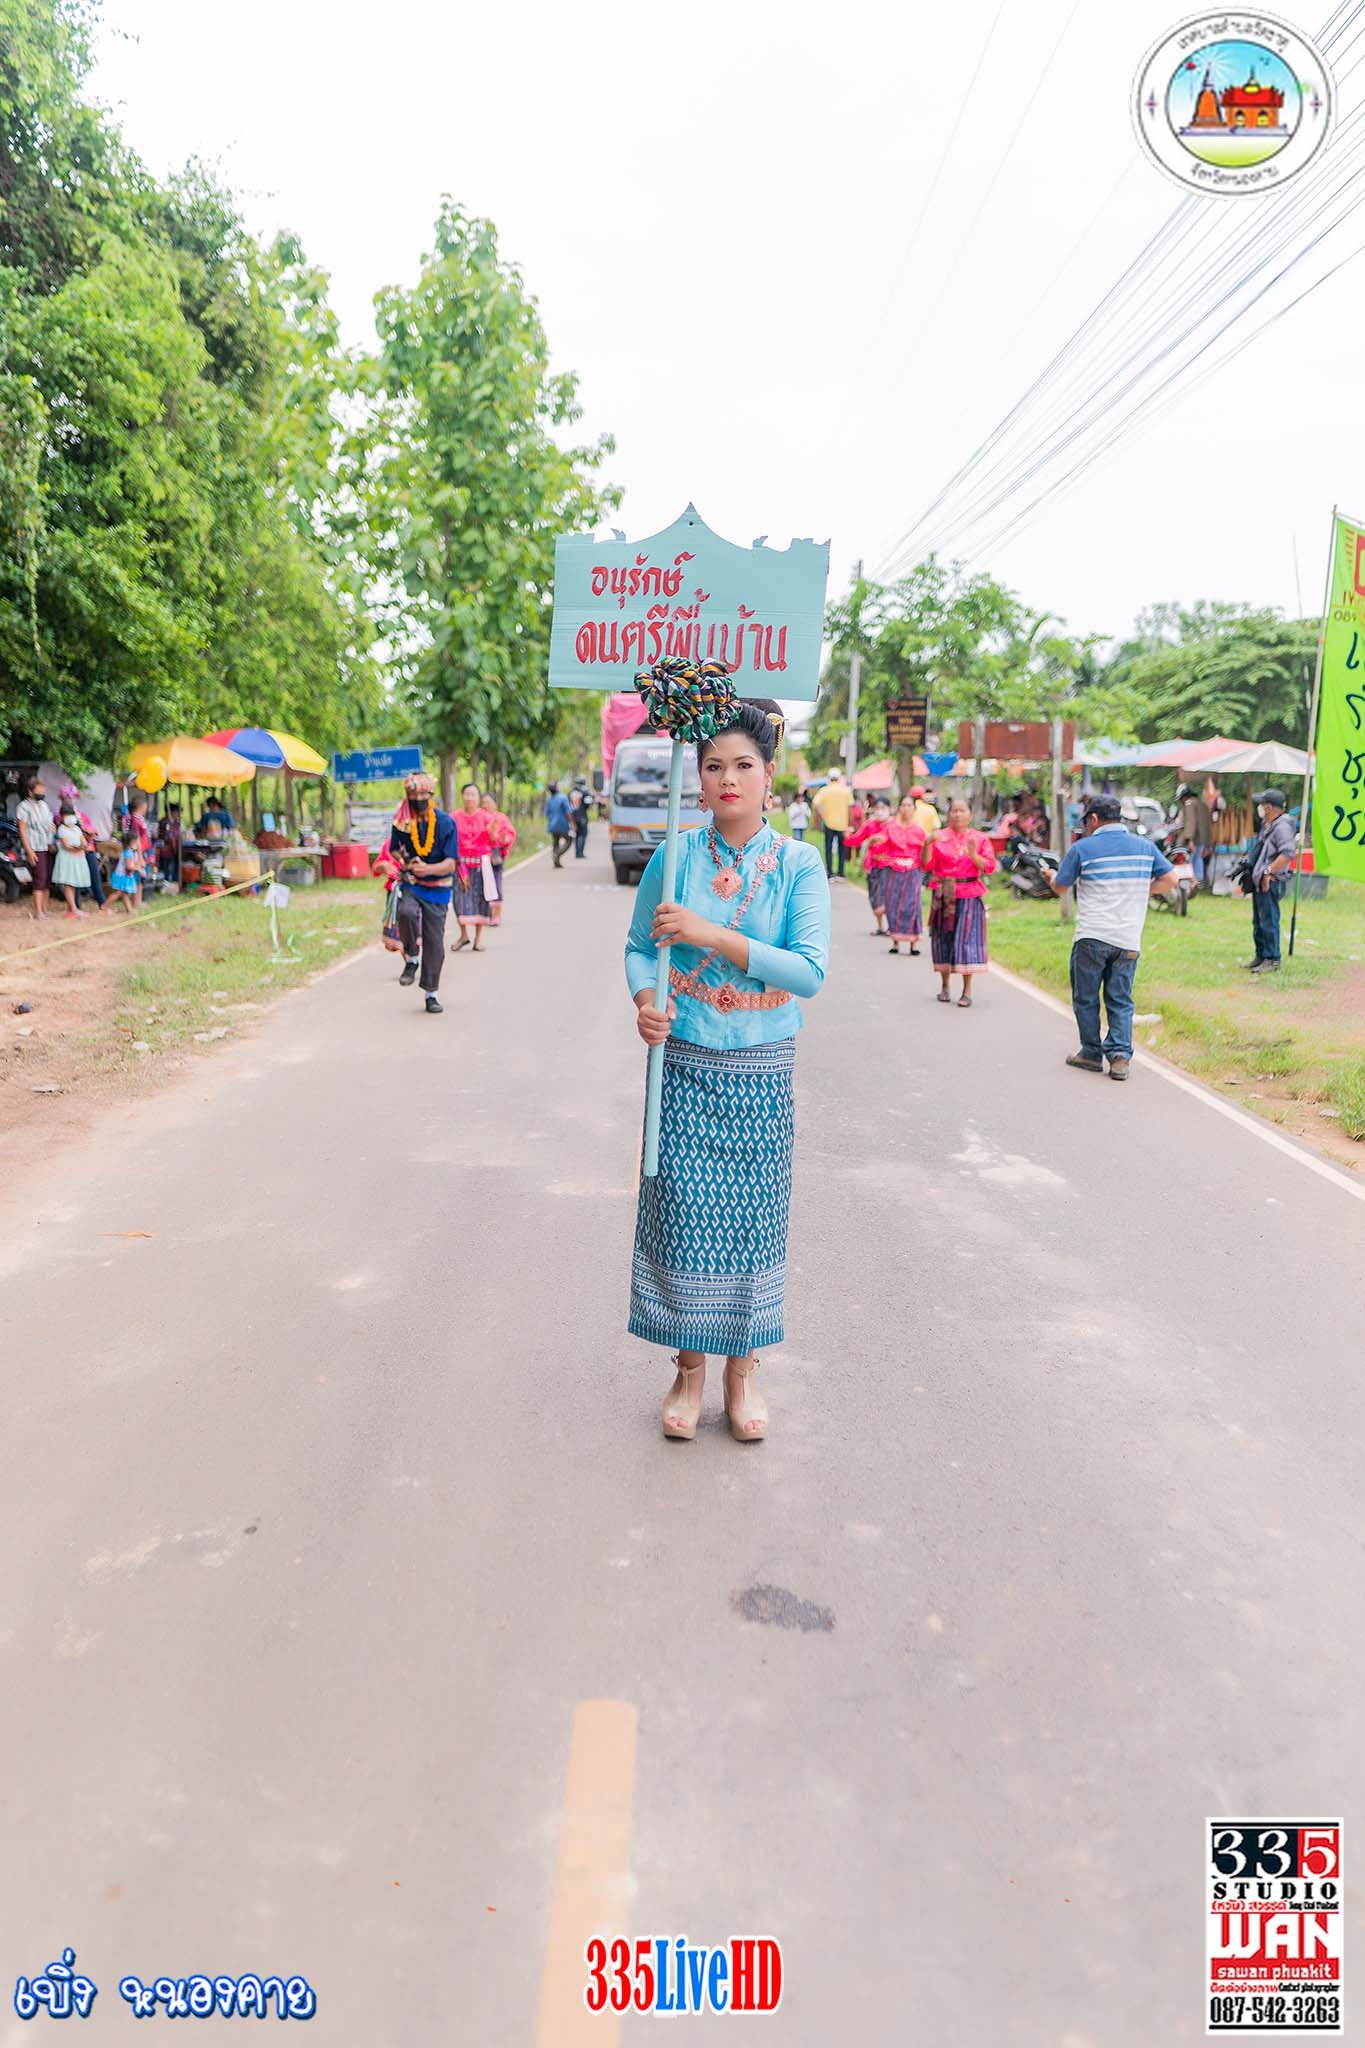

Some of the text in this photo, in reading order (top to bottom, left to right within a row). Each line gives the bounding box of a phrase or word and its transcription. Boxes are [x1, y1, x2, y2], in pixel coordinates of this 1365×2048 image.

[591, 551, 696, 609] อนุรักษ์
[575, 588, 788, 674] ดนตรีพื้นบ้าน
